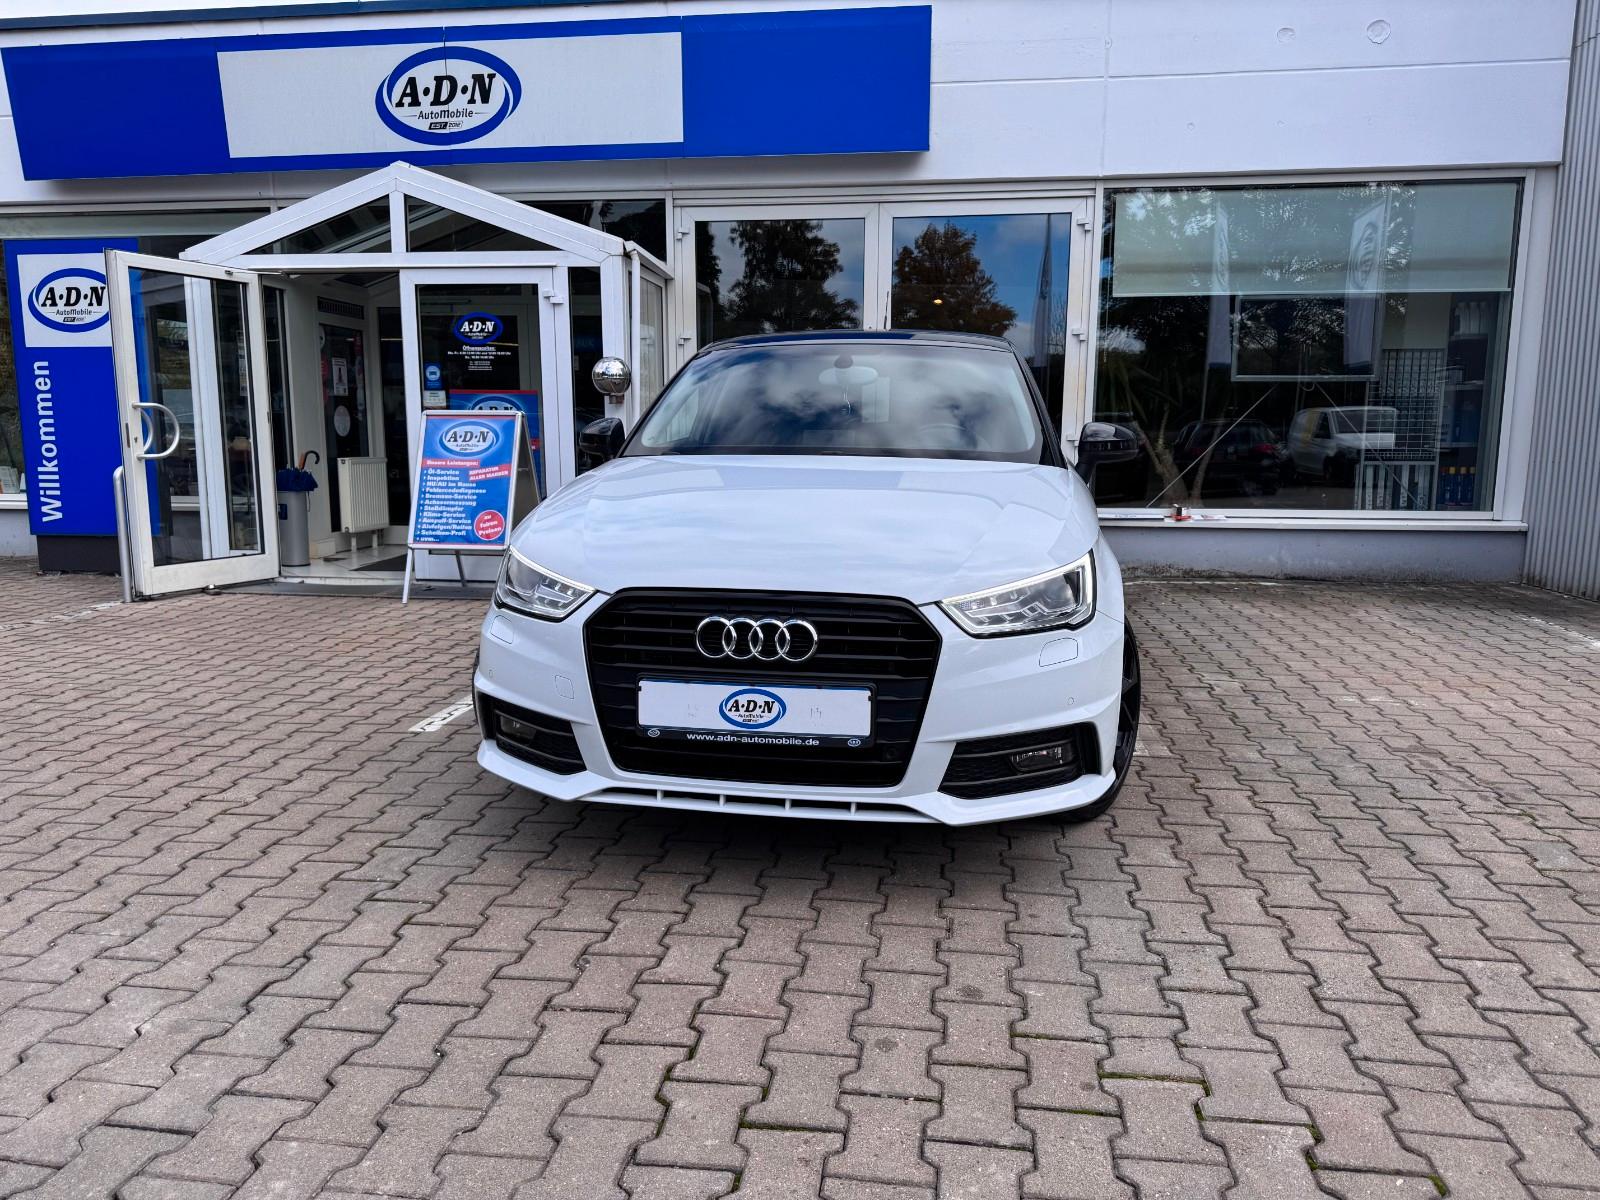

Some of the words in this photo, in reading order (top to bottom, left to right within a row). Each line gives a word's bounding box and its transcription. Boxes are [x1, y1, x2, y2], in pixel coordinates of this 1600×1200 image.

[418, 108, 473, 120] AutoMobile
[56, 308, 92, 316] AutoMobile
[34, 360, 63, 522] Willkommen
[686, 732, 820, 746] www.adn-automobile.de
